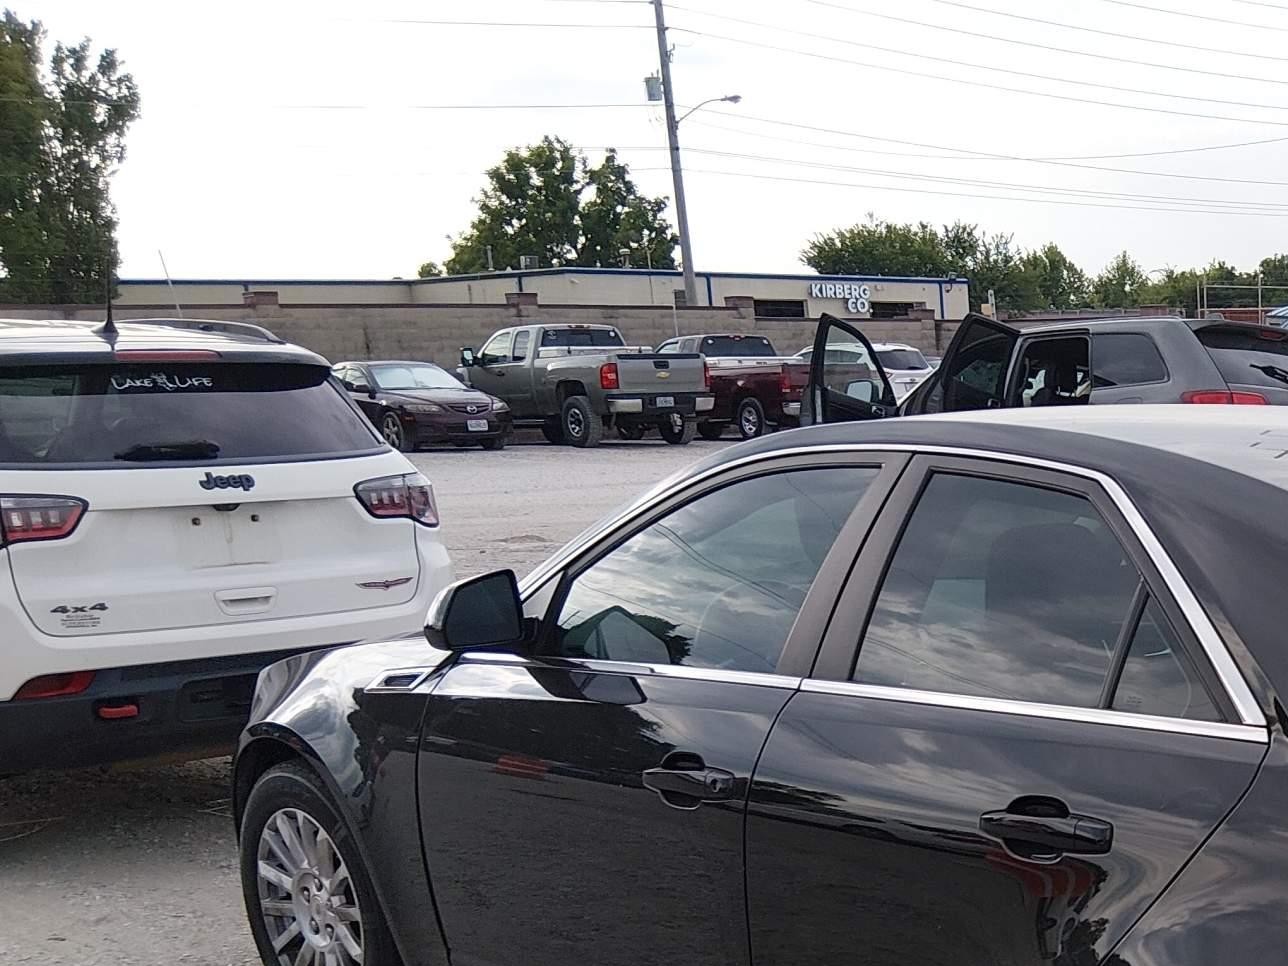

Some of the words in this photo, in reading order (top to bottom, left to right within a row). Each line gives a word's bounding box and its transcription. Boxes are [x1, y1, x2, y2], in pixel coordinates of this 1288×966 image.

[811, 283, 870, 299] KIRBERG
[847, 298, 874, 313] CO.
[111, 378, 154, 390] LAKE
[199, 471, 255, 491] Jeep
